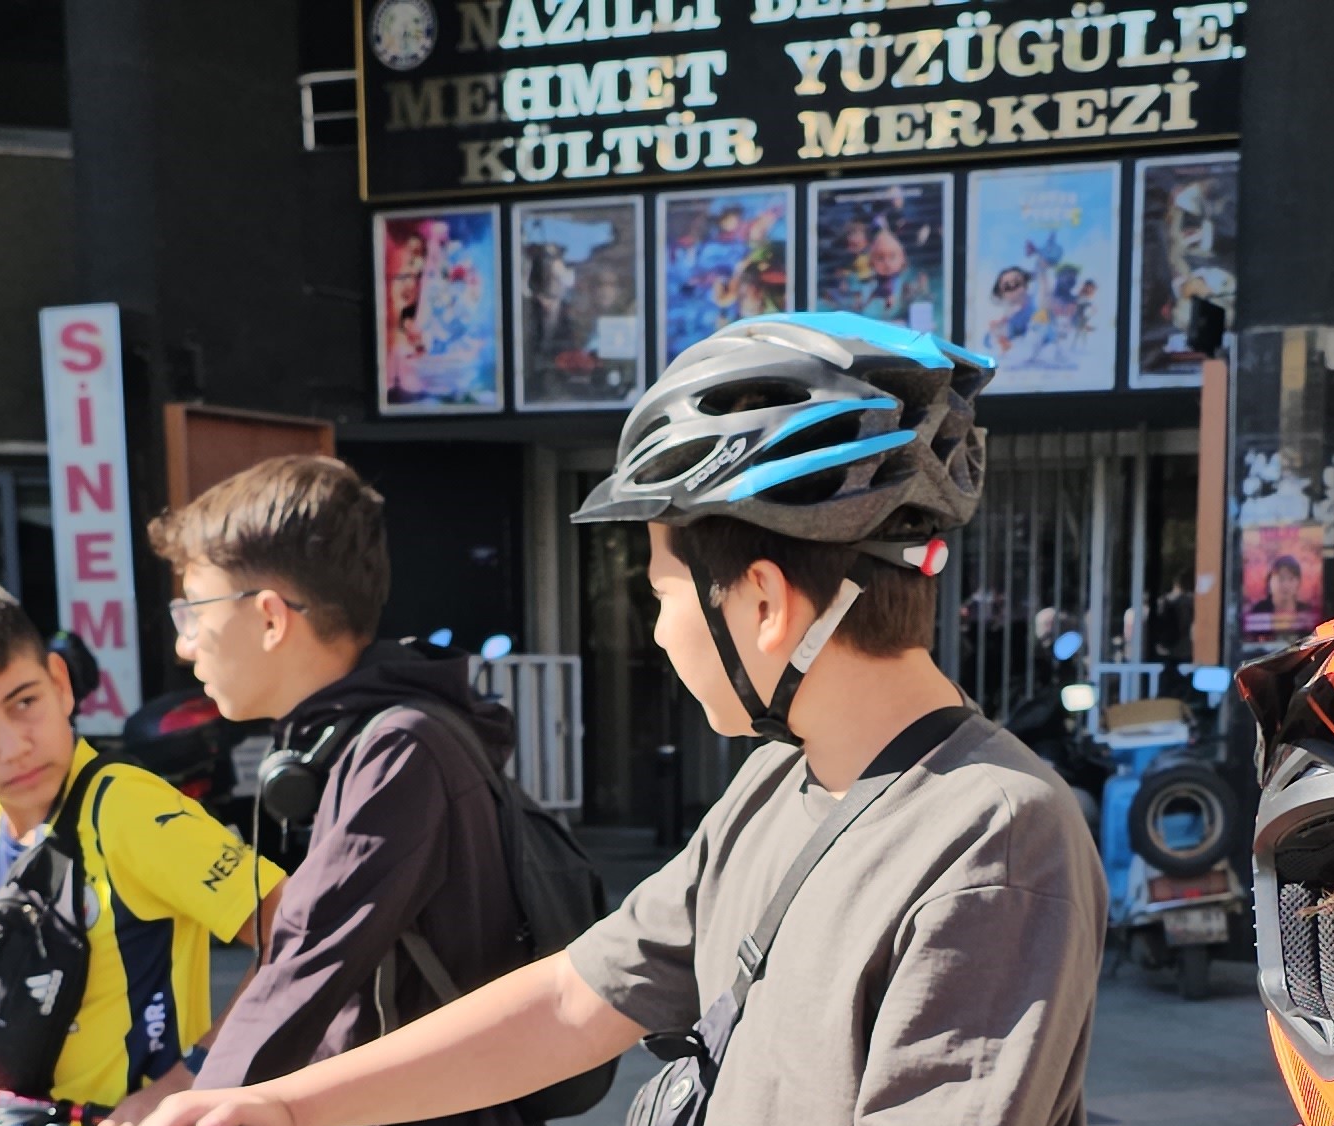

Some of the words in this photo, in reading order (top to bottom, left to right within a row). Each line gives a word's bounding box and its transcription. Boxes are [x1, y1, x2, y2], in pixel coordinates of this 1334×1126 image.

[386, 50, 727, 131] MEHMET
[784, 2, 1247, 95] YÜZÜGÜLE
[459, 110, 763, 184] KÜLTÜR
[797, 68, 1200, 159] MERKEZİ
